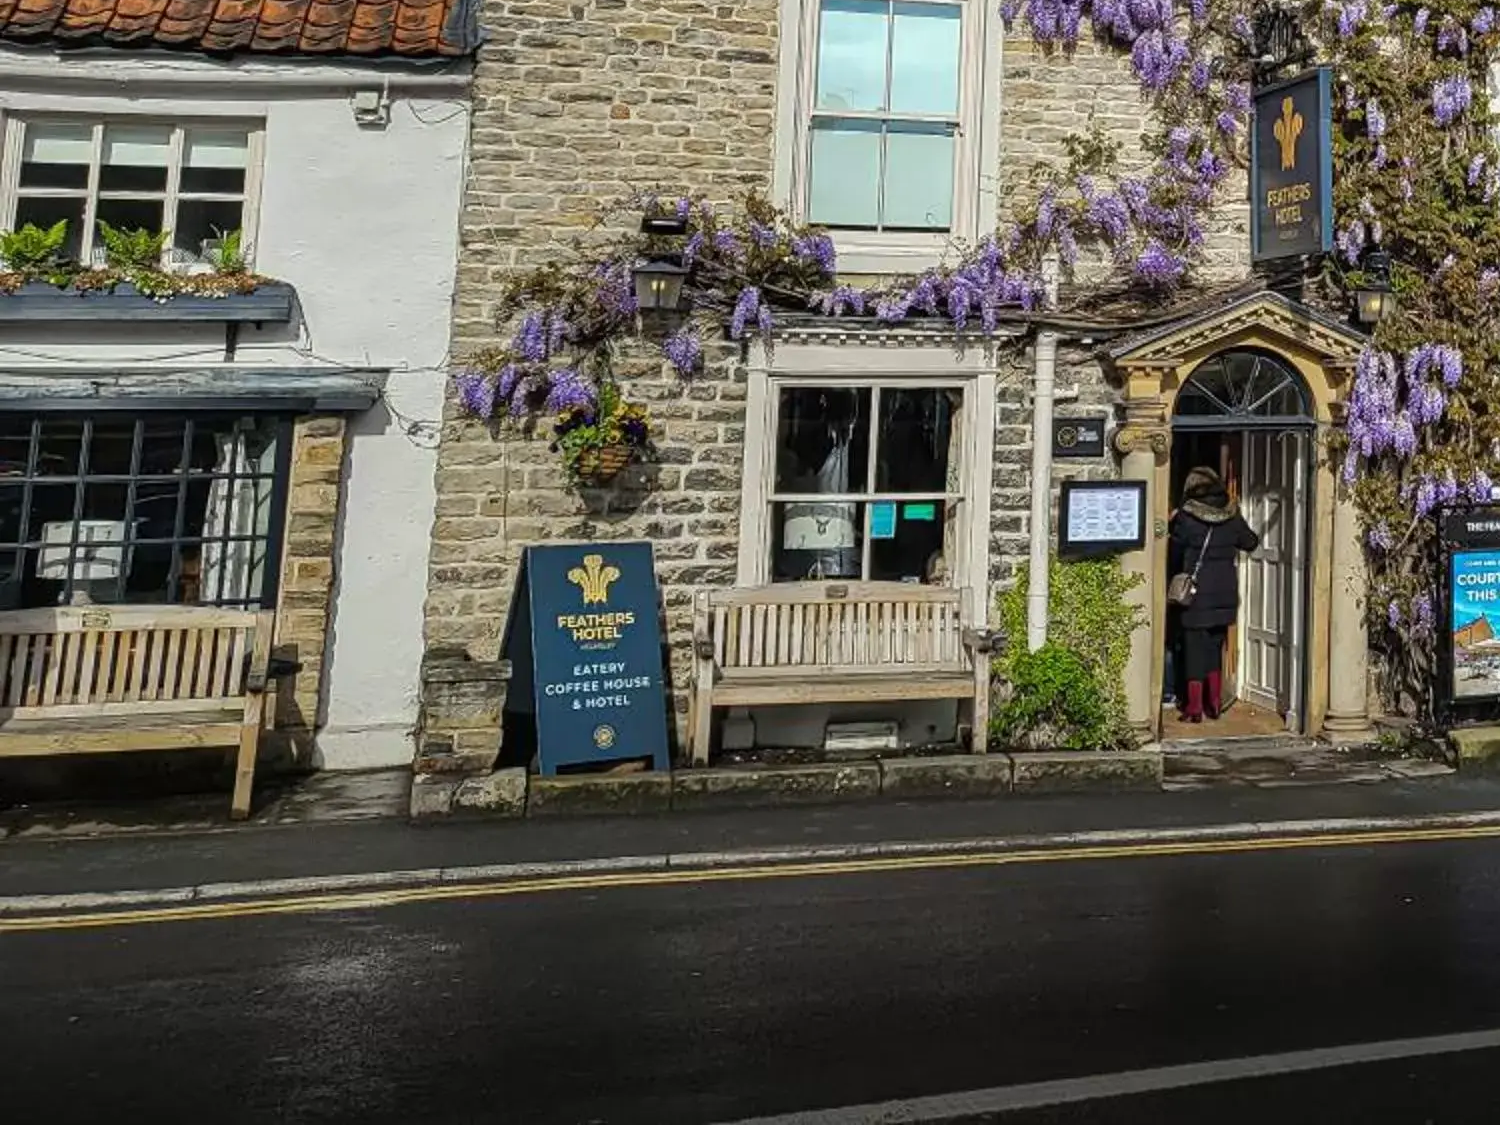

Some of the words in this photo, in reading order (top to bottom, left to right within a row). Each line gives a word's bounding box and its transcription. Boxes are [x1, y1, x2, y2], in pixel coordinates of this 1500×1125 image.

[1275, 204, 1303, 228] HOTEL
[1466, 521, 1483, 532] THE
[1466, 588, 1497, 602] THIS
[557, 612, 635, 628] FEATHERS
[573, 626, 623, 641] HOTEL
[573, 662, 625, 676] EATERY
[545, 680, 599, 696] COFFEE
[603, 676, 651, 691] HOUSE
[585, 695, 631, 709] HOTEL
